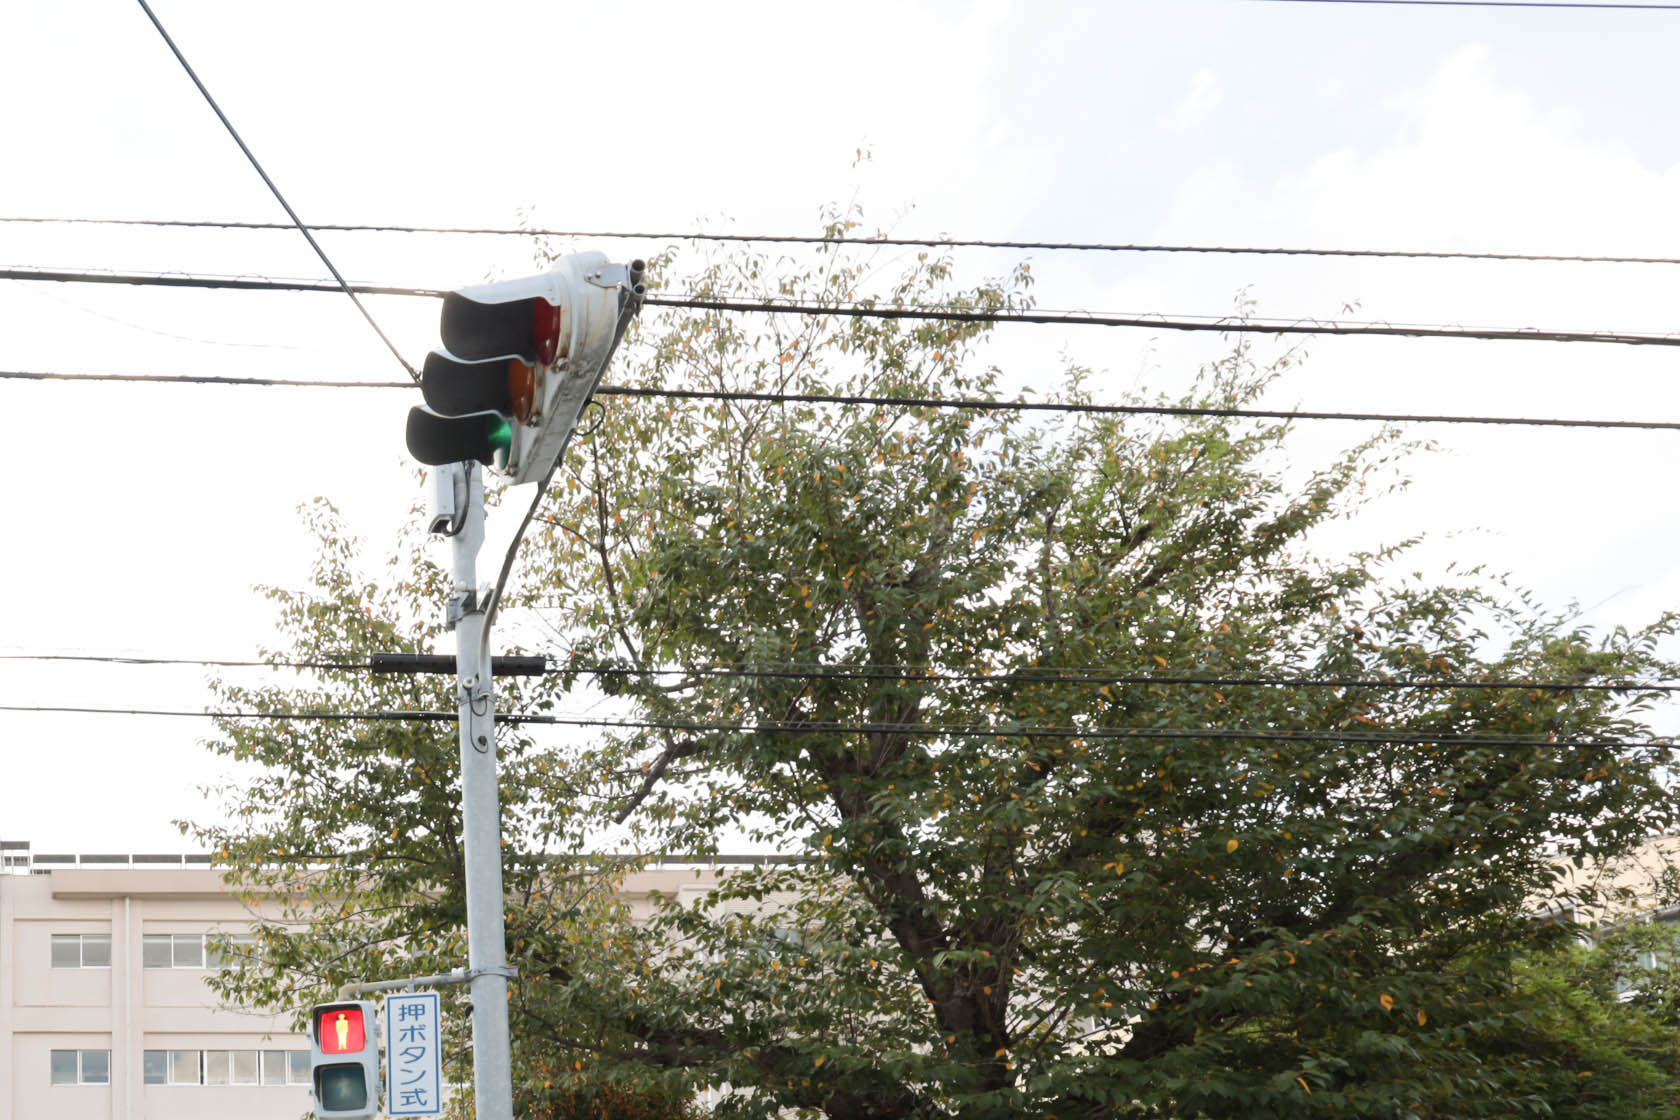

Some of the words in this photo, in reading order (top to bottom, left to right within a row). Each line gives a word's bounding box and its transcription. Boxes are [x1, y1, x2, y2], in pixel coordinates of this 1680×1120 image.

[399, 1003, 428, 1107] 押ボタン式
